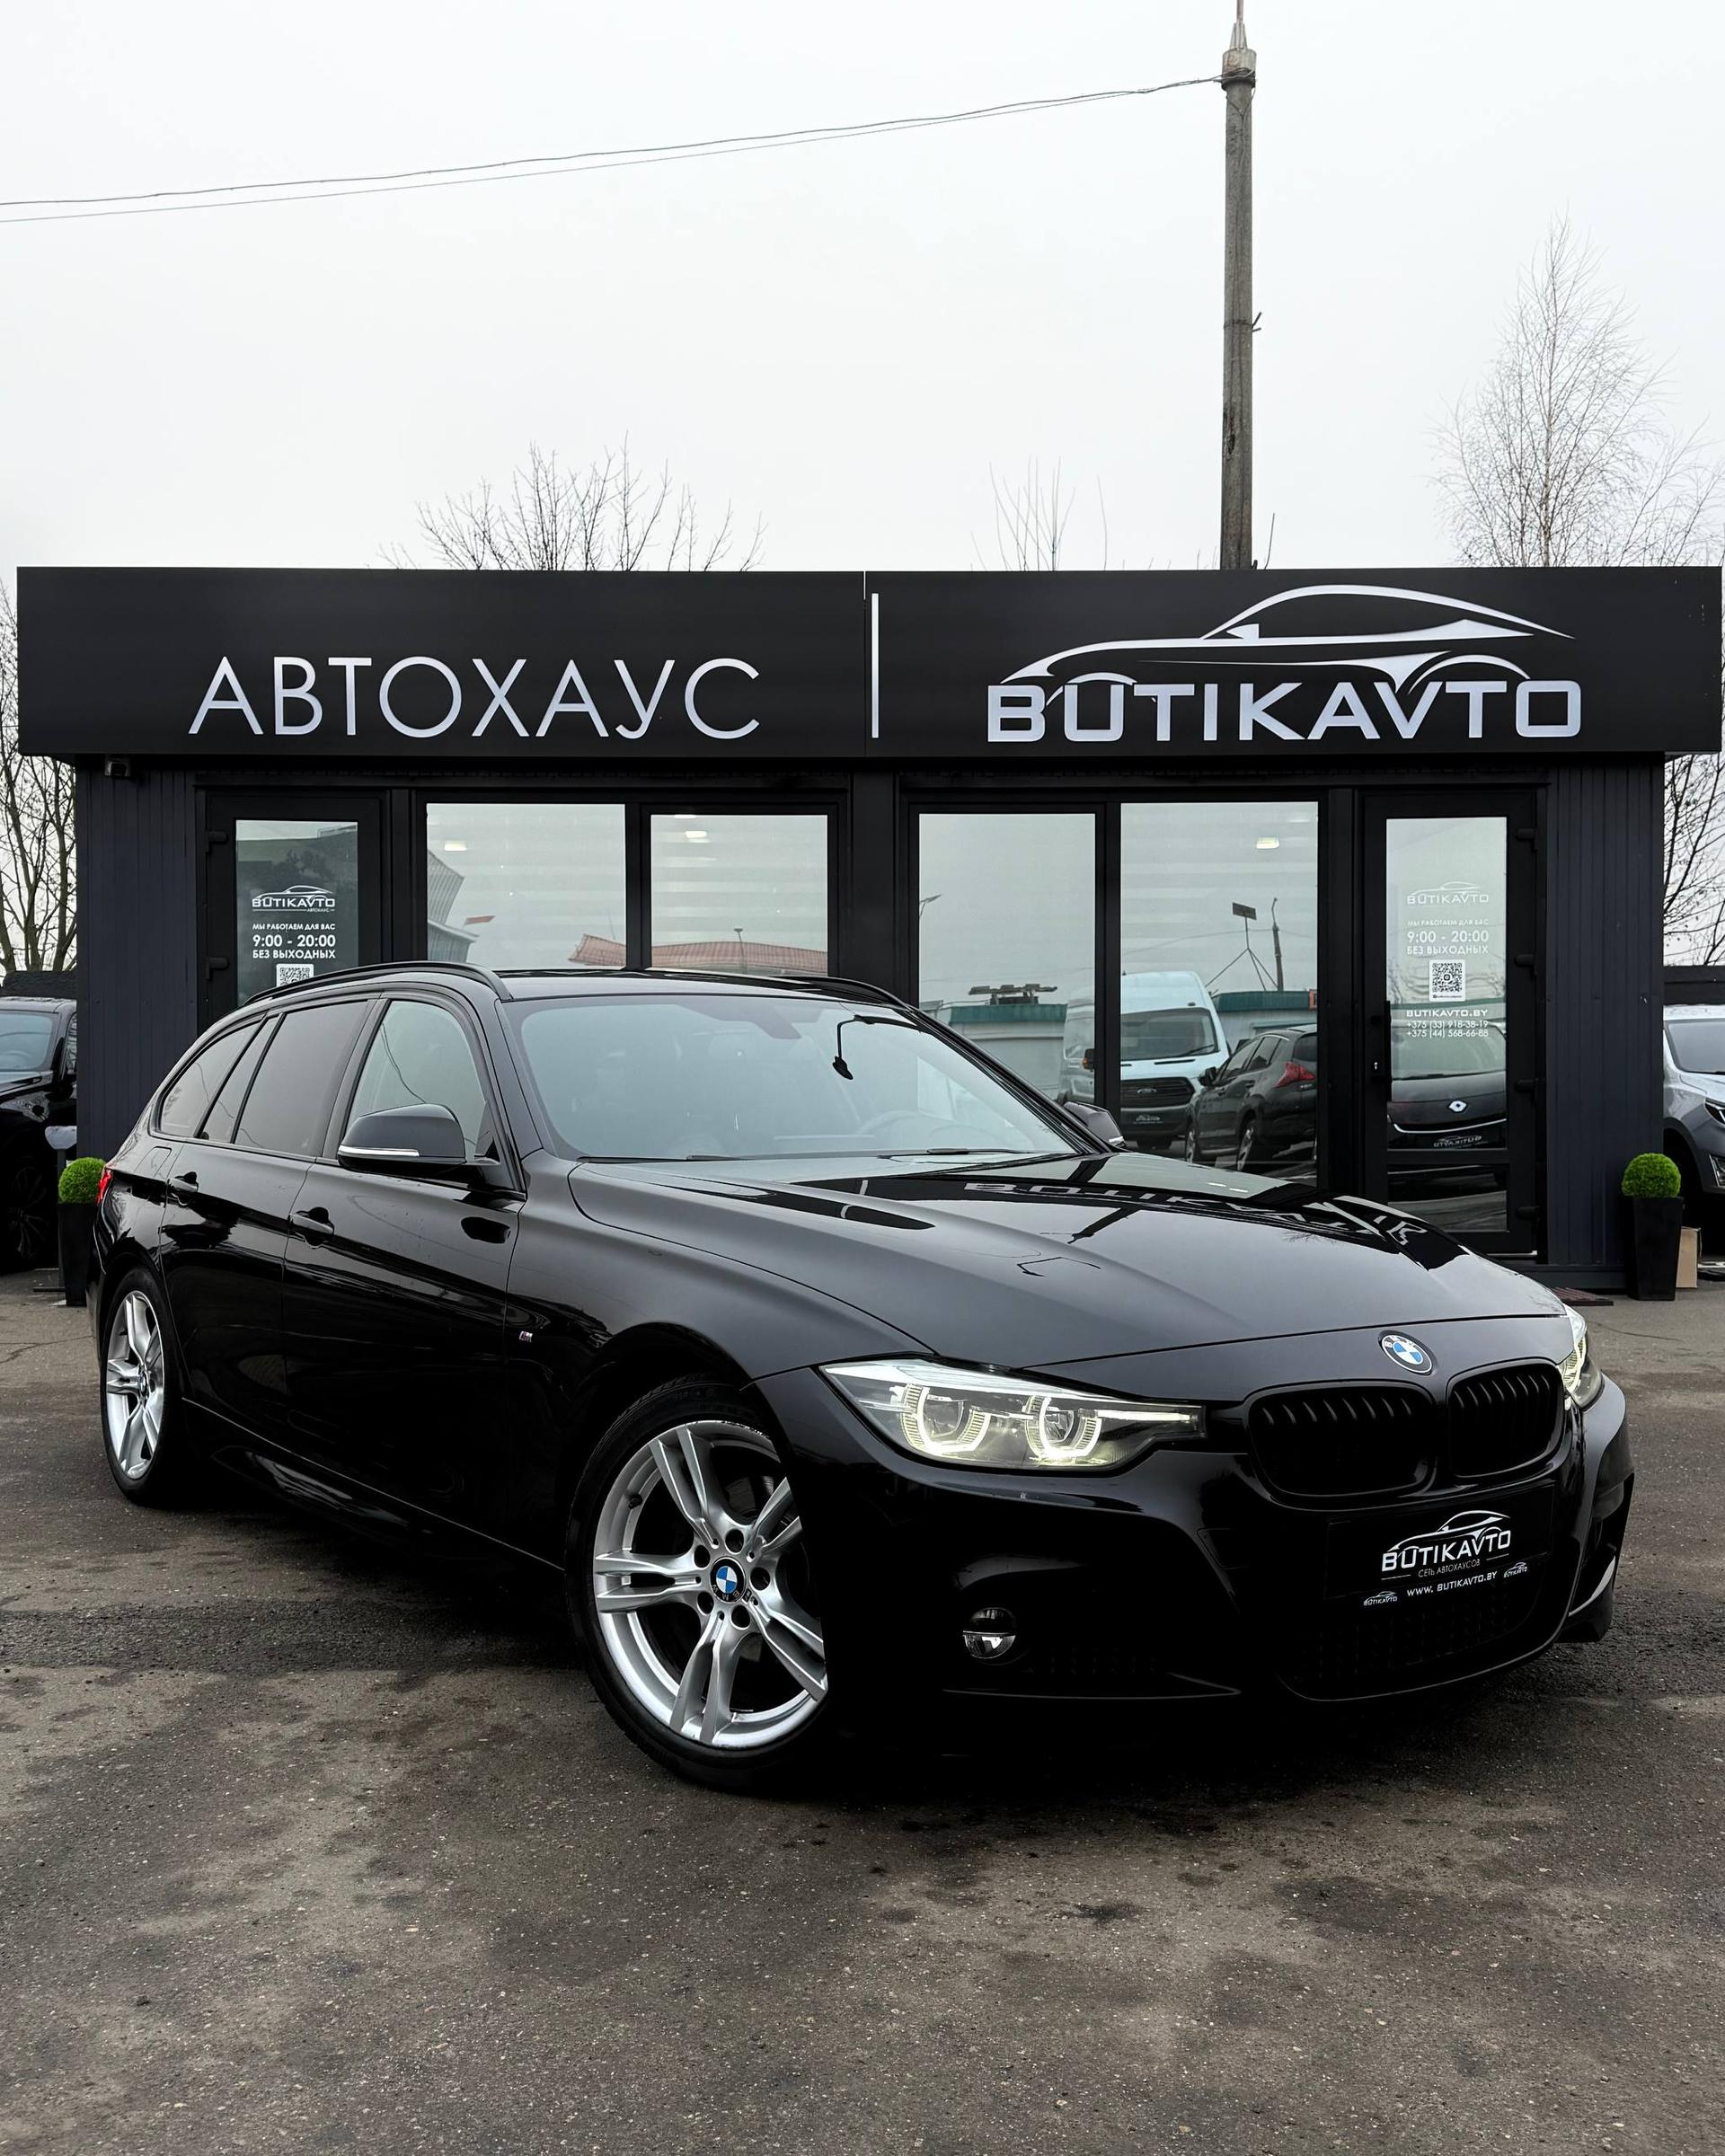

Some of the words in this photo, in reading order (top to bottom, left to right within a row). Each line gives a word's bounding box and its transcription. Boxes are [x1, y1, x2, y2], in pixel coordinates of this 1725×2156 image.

[188, 655, 760, 739] АВТОХАУС
[987, 680, 1581, 742] BUTIKAVTO
[252, 897, 335, 907] BUTIKAVTO
[1407, 894, 1488, 905] BUTIKAVTO
[305, 923, 319, 932] ДЛЯ
[252, 934, 282, 948] 9:00
[297, 934, 336, 948] 20:00
[1407, 931, 1436, 943] 9:00
[1451, 930, 1489, 942] 20:00
[252, 950, 270, 959] БЕЗ
[273, 950, 336, 959] ВЫХОДНЫХ
[1407, 946, 1424, 955] БЕЗ
[1427, 945, 1489, 955] ВЫХОДНЫХ
[1407, 1021, 1427, 1029] +375
[1429, 1021, 1445, 1029] (33)
[1447, 1021, 1489, 1029] 918-38-19
[1407, 1029, 1427, 1038] +375
[1429, 1029, 1445, 1038] (44)
[1447, 1029, 1489, 1038] 568-66-88
[1382, 1530, 1511, 1571] BUTIKAVTO
[1437, 1559, 1481, 1574] АВТОХАУСОВ
[1407, 1586, 1434, 1596] WWW.
[1437, 1571, 1498, 1592] BUTIKAVTO.BY
[1363, 1596, 1398, 1606] BUTIKAVTO
